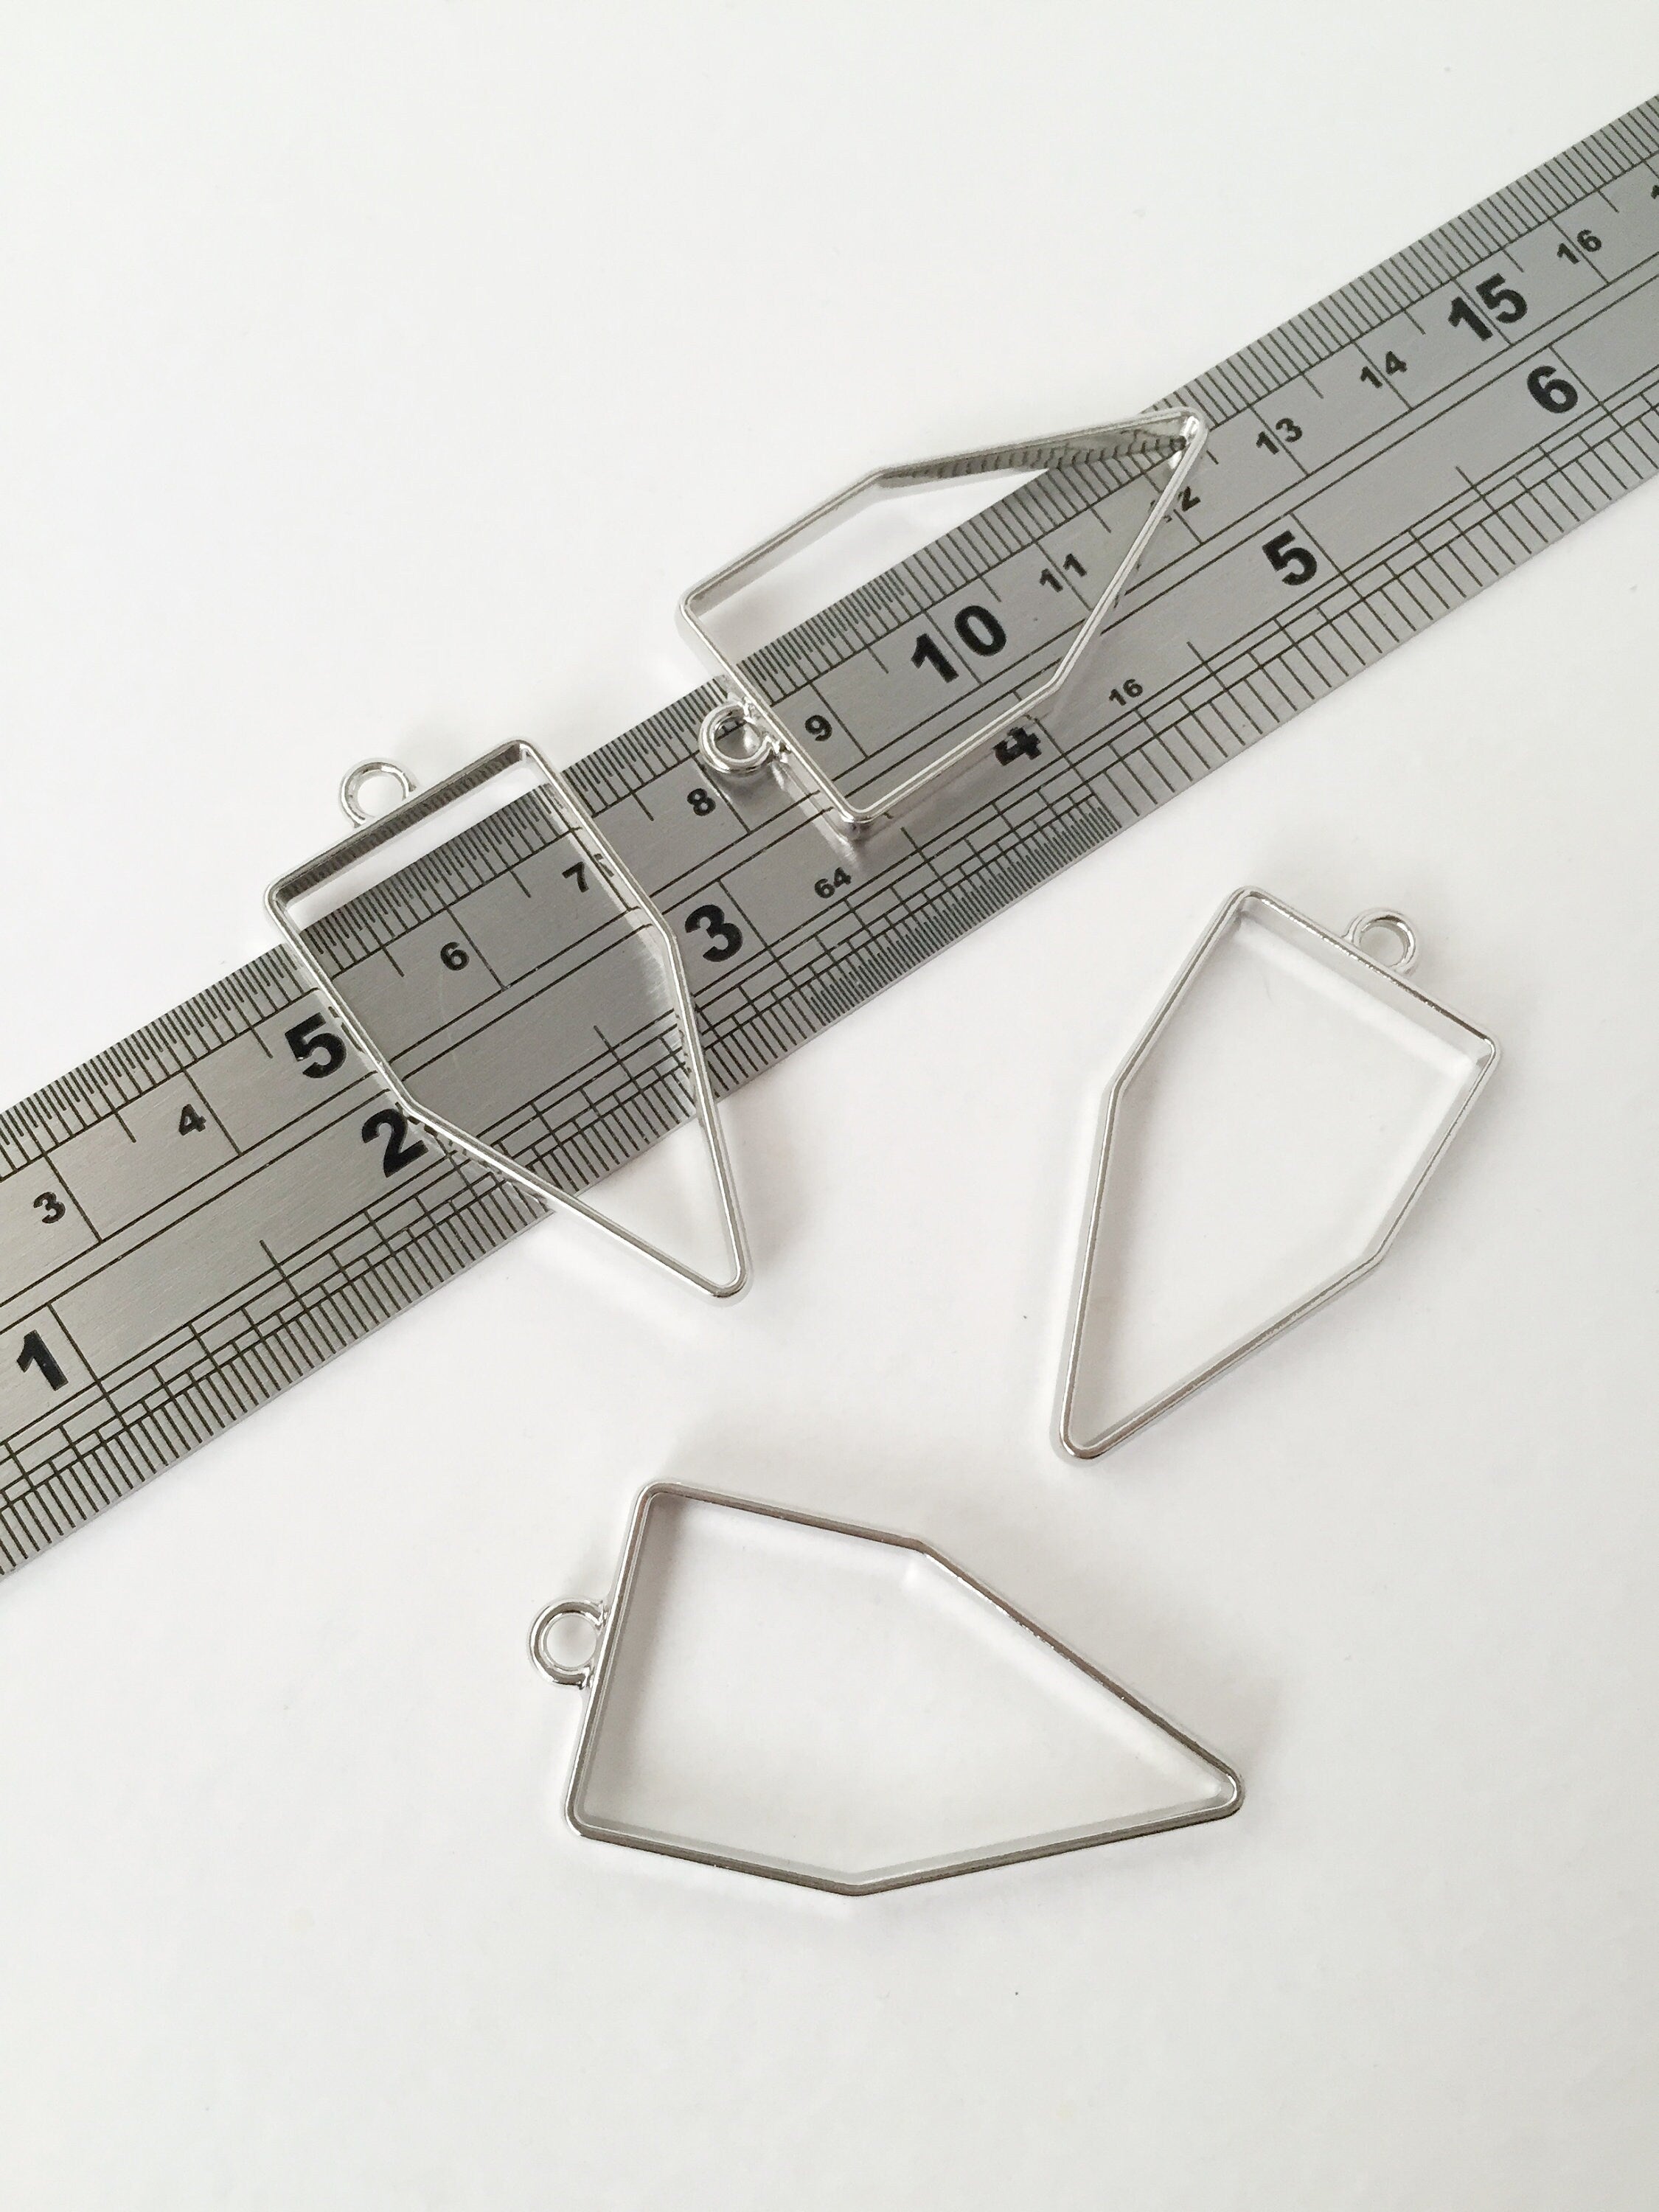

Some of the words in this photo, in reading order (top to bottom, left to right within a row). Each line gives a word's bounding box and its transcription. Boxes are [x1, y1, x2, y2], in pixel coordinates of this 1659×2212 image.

[1557, 229, 1602, 265] 16
[1447, 273, 1528, 341] 15
[1360, 351, 1408, 389] 14
[1526, 365, 1579, 414] 6
[1256, 417, 1303, 455] 13
[1038, 554, 1087, 593] 11
[1262, 530, 1318, 586] 5
[911, 605, 1006, 683] 10
[1108, 678, 1144, 707] 16
[804, 714, 832, 741] 9
[686, 787, 716, 816] 8
[562, 861, 590, 893] 7
[813, 867, 852, 899] 64
[684, 904, 743, 962] 3
[440, 941, 470, 971] 6
[284, 1012, 347, 1079] 5
[178, 1104, 206, 1135] 4
[361, 1107, 428, 1178] 2
[33, 1192, 66, 1224] 3
[16, 1329, 68, 1391] 1
